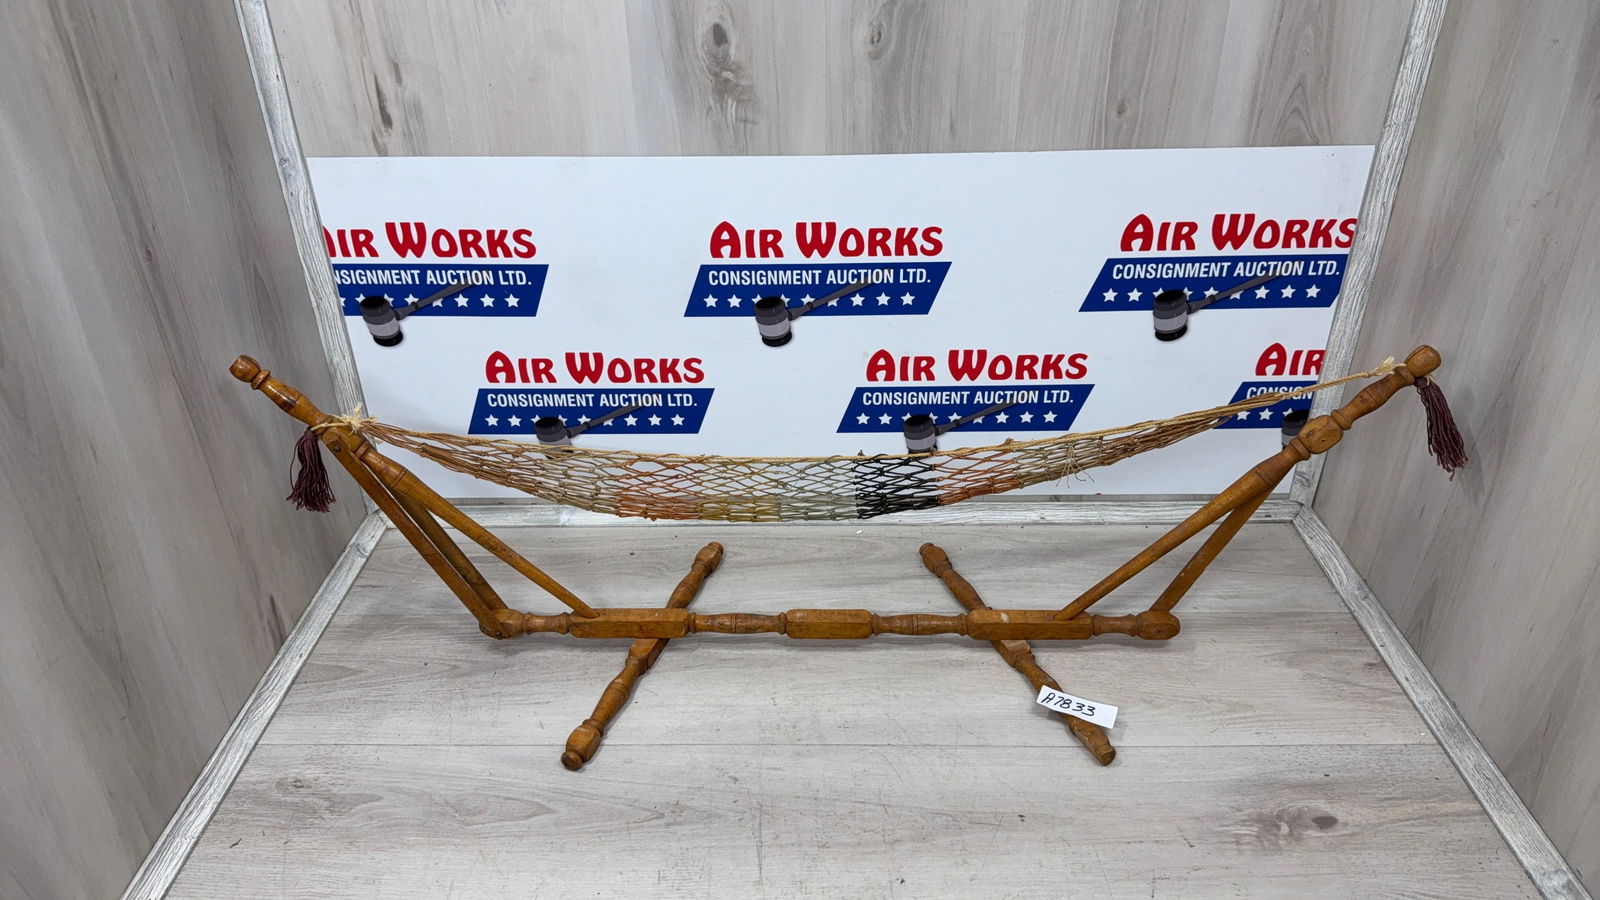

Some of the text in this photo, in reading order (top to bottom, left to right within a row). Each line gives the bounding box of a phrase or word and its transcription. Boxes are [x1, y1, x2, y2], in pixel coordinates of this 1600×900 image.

[384, 221, 537, 259] WORKS
[709, 220, 944, 259] AIR WORKS
[1120, 213, 1358, 252] AIR WORKS
[426, 270, 495, 286] AUCTION
[499, 270, 532, 286] LTD.
[708, 268, 931, 286] CONSIGNMENT AUCTION LTD.
[1112, 260, 1340, 280] CONSIGNMENT AUCTION LTD.
[485, 350, 705, 384] AIR WORKS
[865, 348, 1088, 382] AIR WORKS
[1255, 342, 1327, 376] AIR
[487, 393, 698, 408] CONSIGNMENT AUCTION LTD.
[862, 389, 1074, 406] CONSIGNMENT AUCTION LTD.
[1041, 692, 1096, 717] A7833
